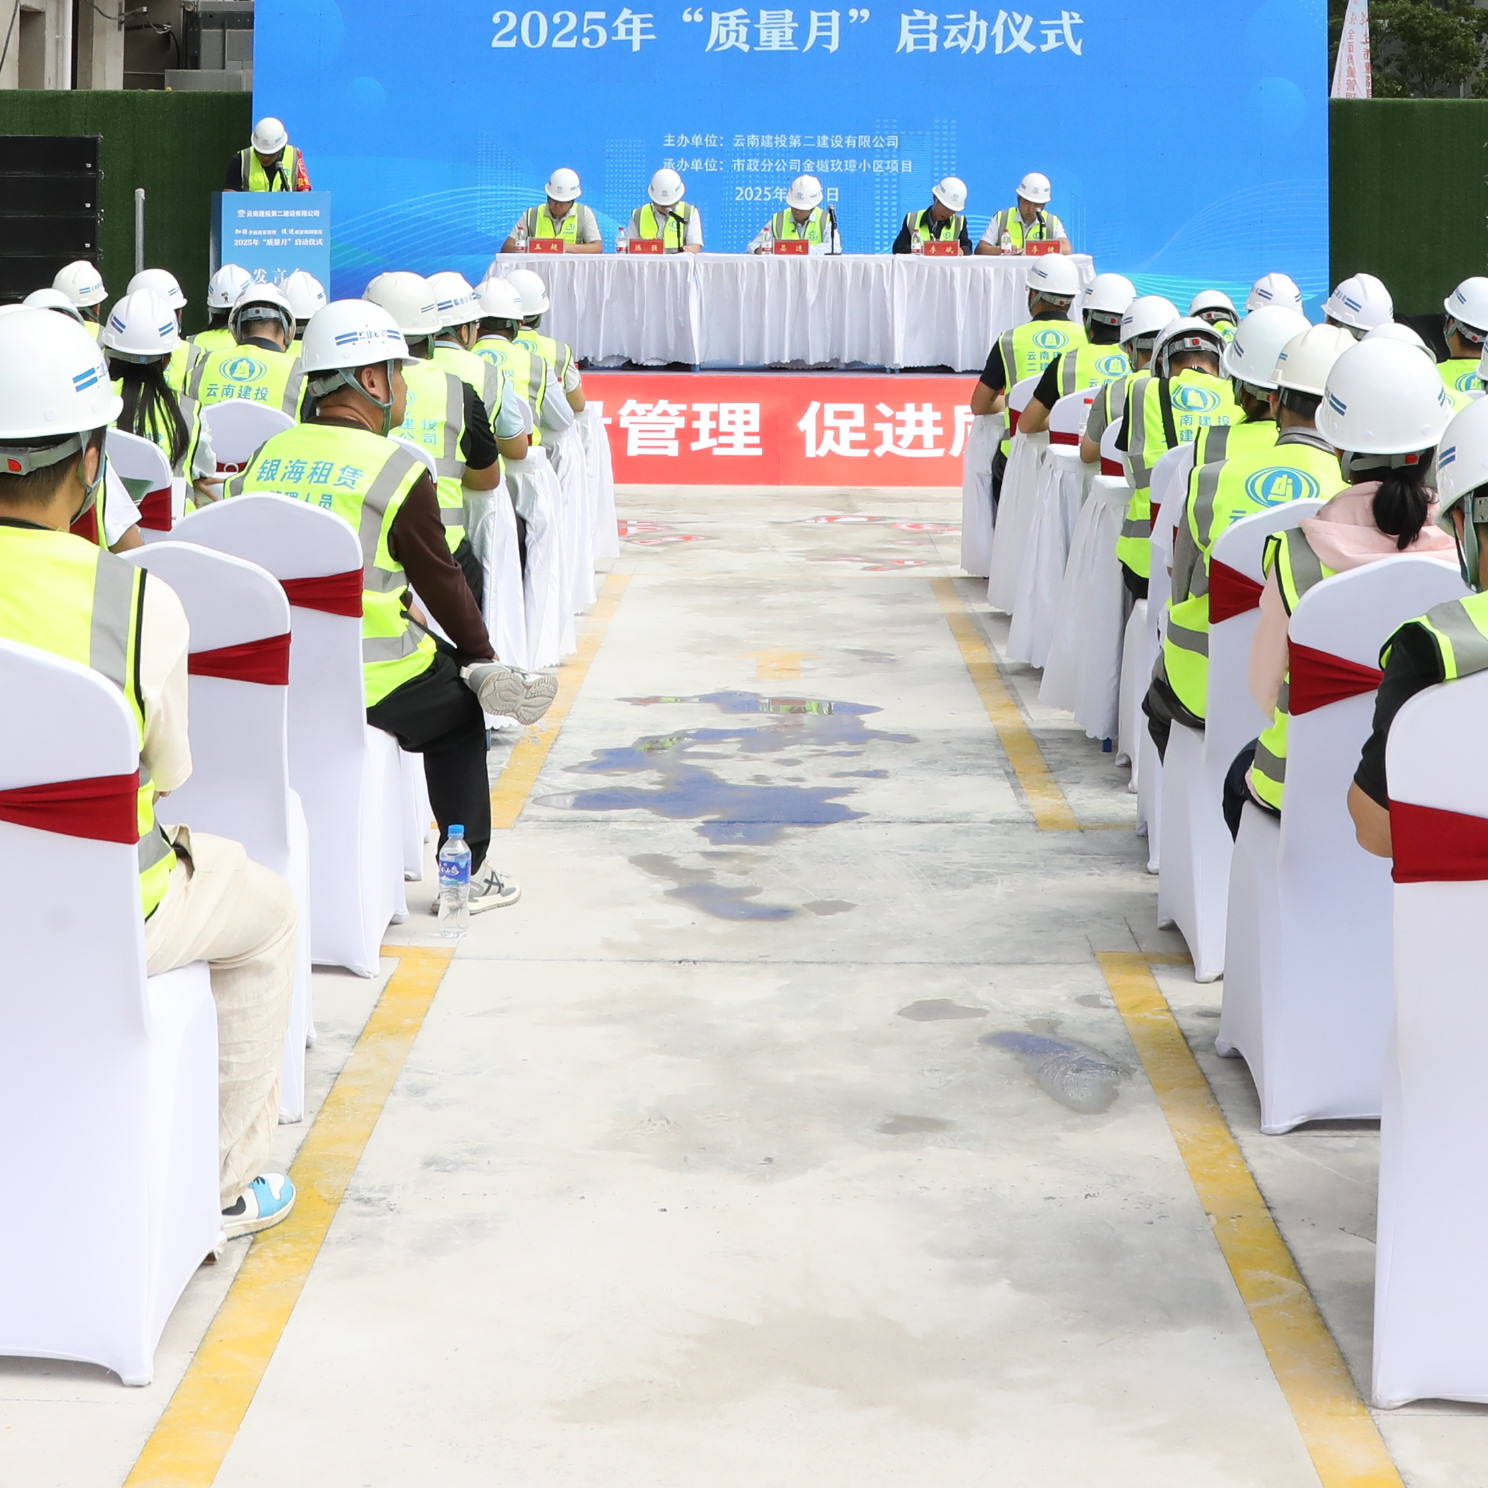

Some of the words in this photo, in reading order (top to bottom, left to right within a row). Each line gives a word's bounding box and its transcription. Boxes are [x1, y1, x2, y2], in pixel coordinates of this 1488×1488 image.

[253, 267, 301, 286] 发言
[206, 383, 270, 402] 云南建投
[604, 398, 764, 456] 管理
[255, 458, 365, 490] 银海租赁
